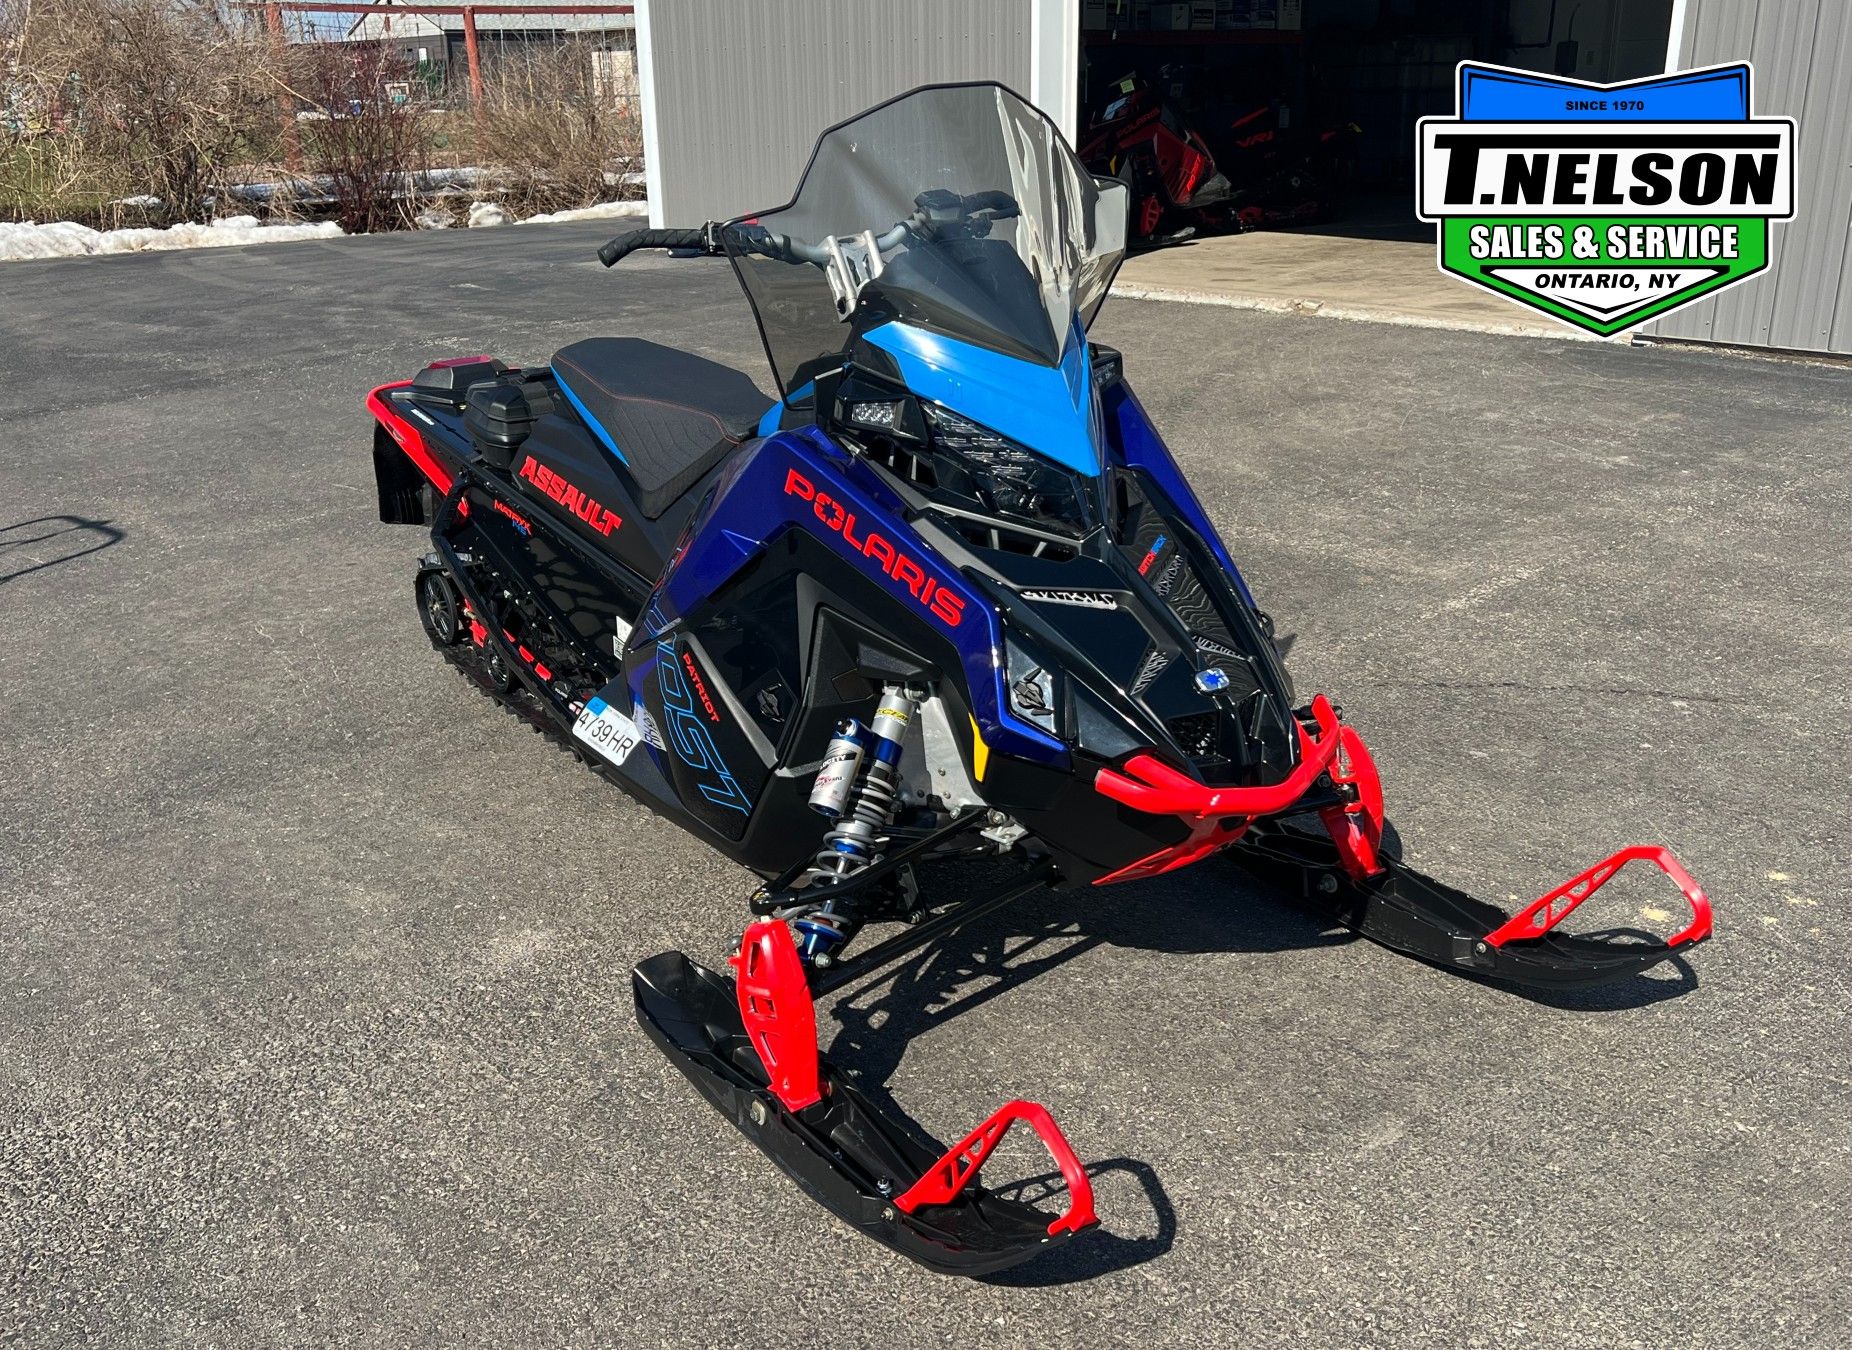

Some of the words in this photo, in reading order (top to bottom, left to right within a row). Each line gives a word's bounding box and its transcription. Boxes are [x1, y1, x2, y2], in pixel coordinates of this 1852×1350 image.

[519, 455, 623, 538] ASSAULT
[783, 467, 966, 628] POLARIS
[682, 652, 720, 723] PATRIOT
